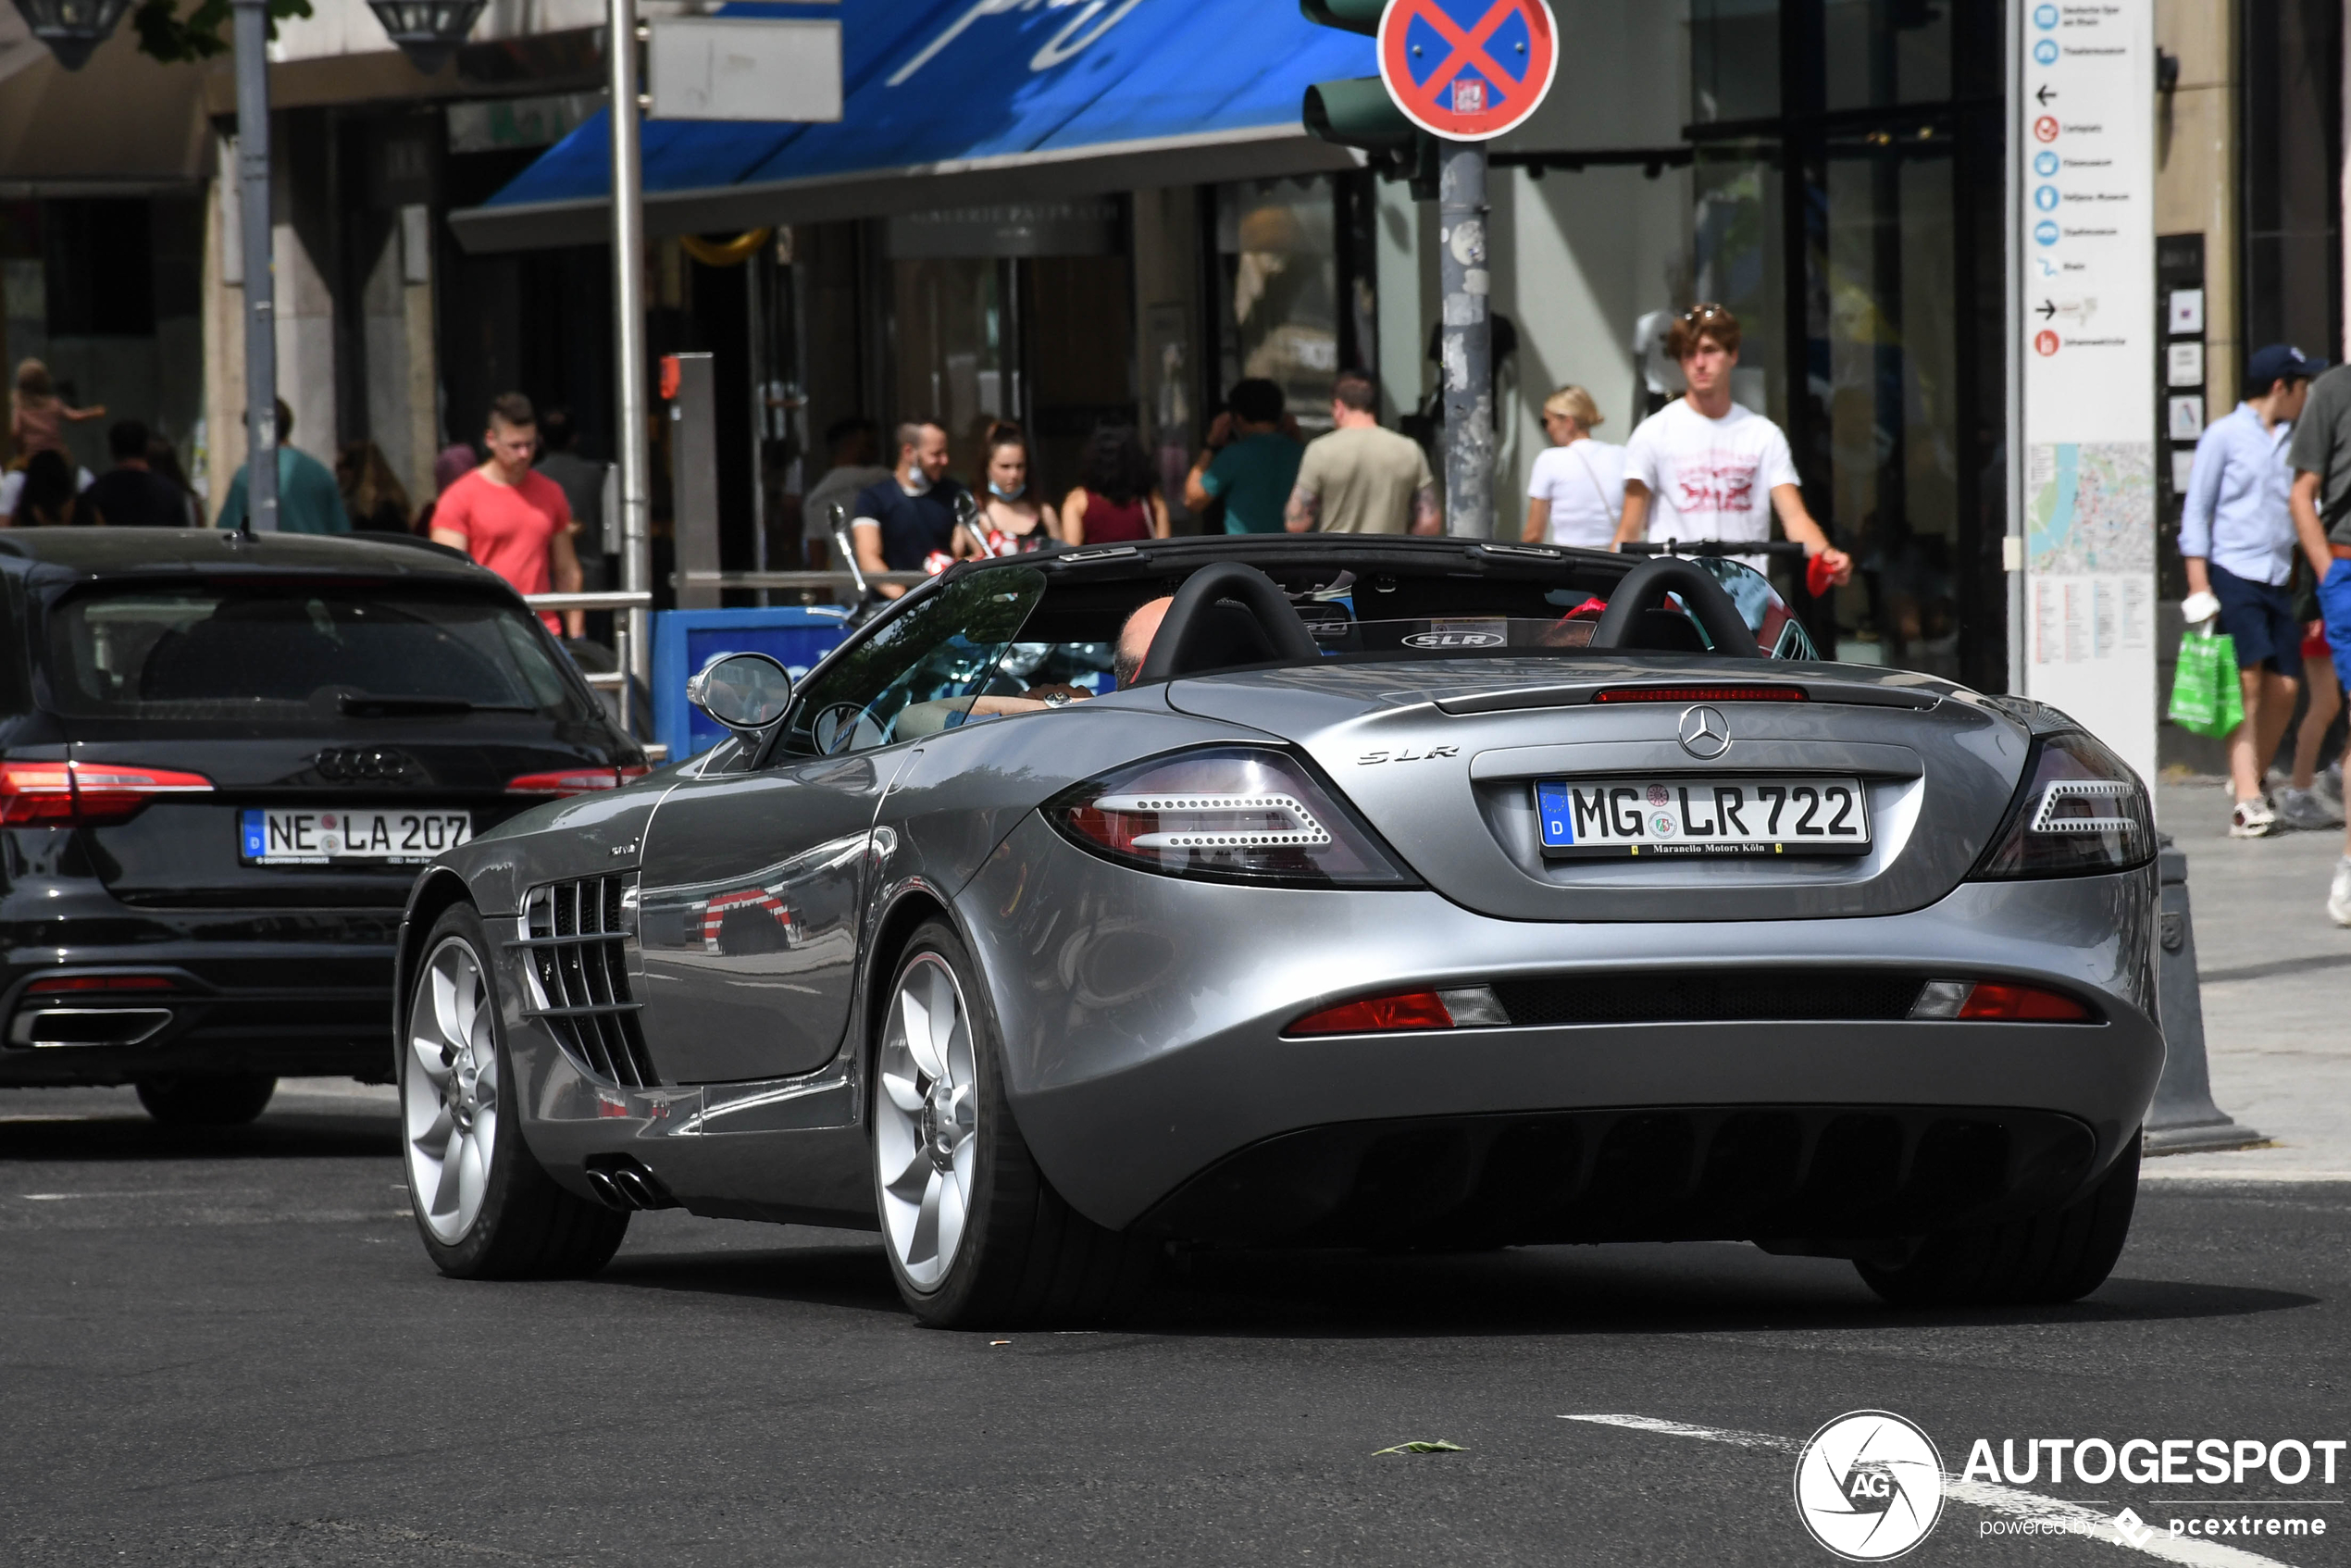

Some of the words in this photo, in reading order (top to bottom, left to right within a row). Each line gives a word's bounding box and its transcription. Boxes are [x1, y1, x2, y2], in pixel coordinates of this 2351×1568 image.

[1415, 635, 1487, 646] SLR
[1357, 744, 1460, 765] SLR
[1551, 821, 1563, 835] D
[1573, 788, 1645, 838] MG
[1678, 787, 1749, 836] LR
[1757, 787, 1857, 836] 722
[250, 837, 260, 850] D
[268, 815, 317, 850] NE
[343, 815, 391, 850] LA
[401, 815, 466, 850] 207
[1653, 844, 1702, 854] Maranello
[1705, 843, 1739, 853] Motors
[1742, 841, 1765, 852] Köln
